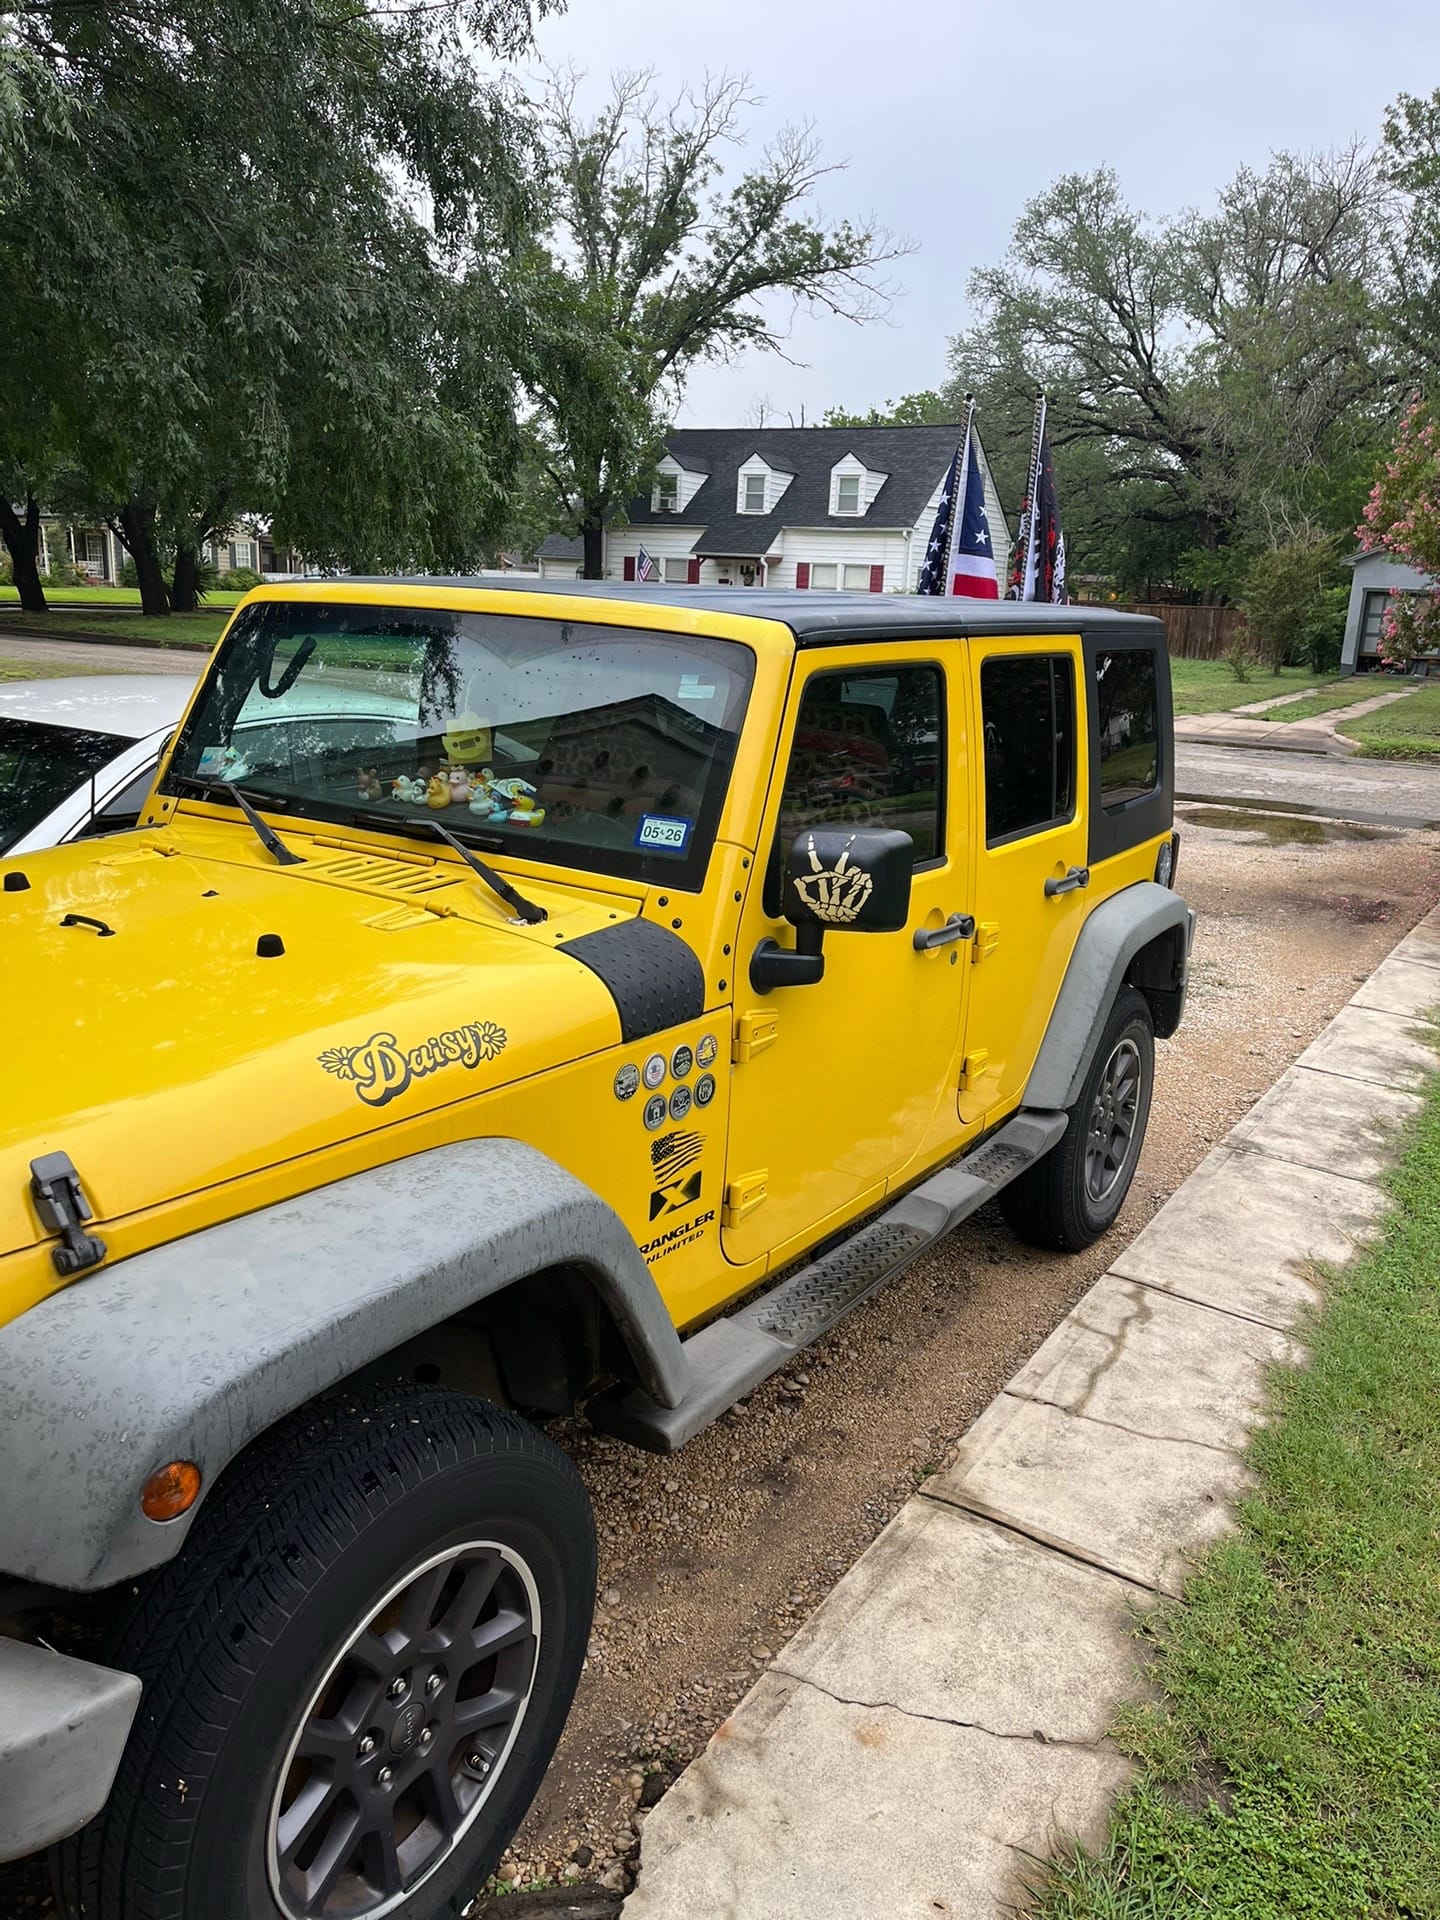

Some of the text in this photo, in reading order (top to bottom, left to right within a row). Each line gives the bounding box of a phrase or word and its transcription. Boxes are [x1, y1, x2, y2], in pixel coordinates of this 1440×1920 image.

[351, 1025, 484, 1107] Daisy
[639, 1210, 715, 1254] RANGLER
[646, 1230, 704, 1265] NLIMITED
